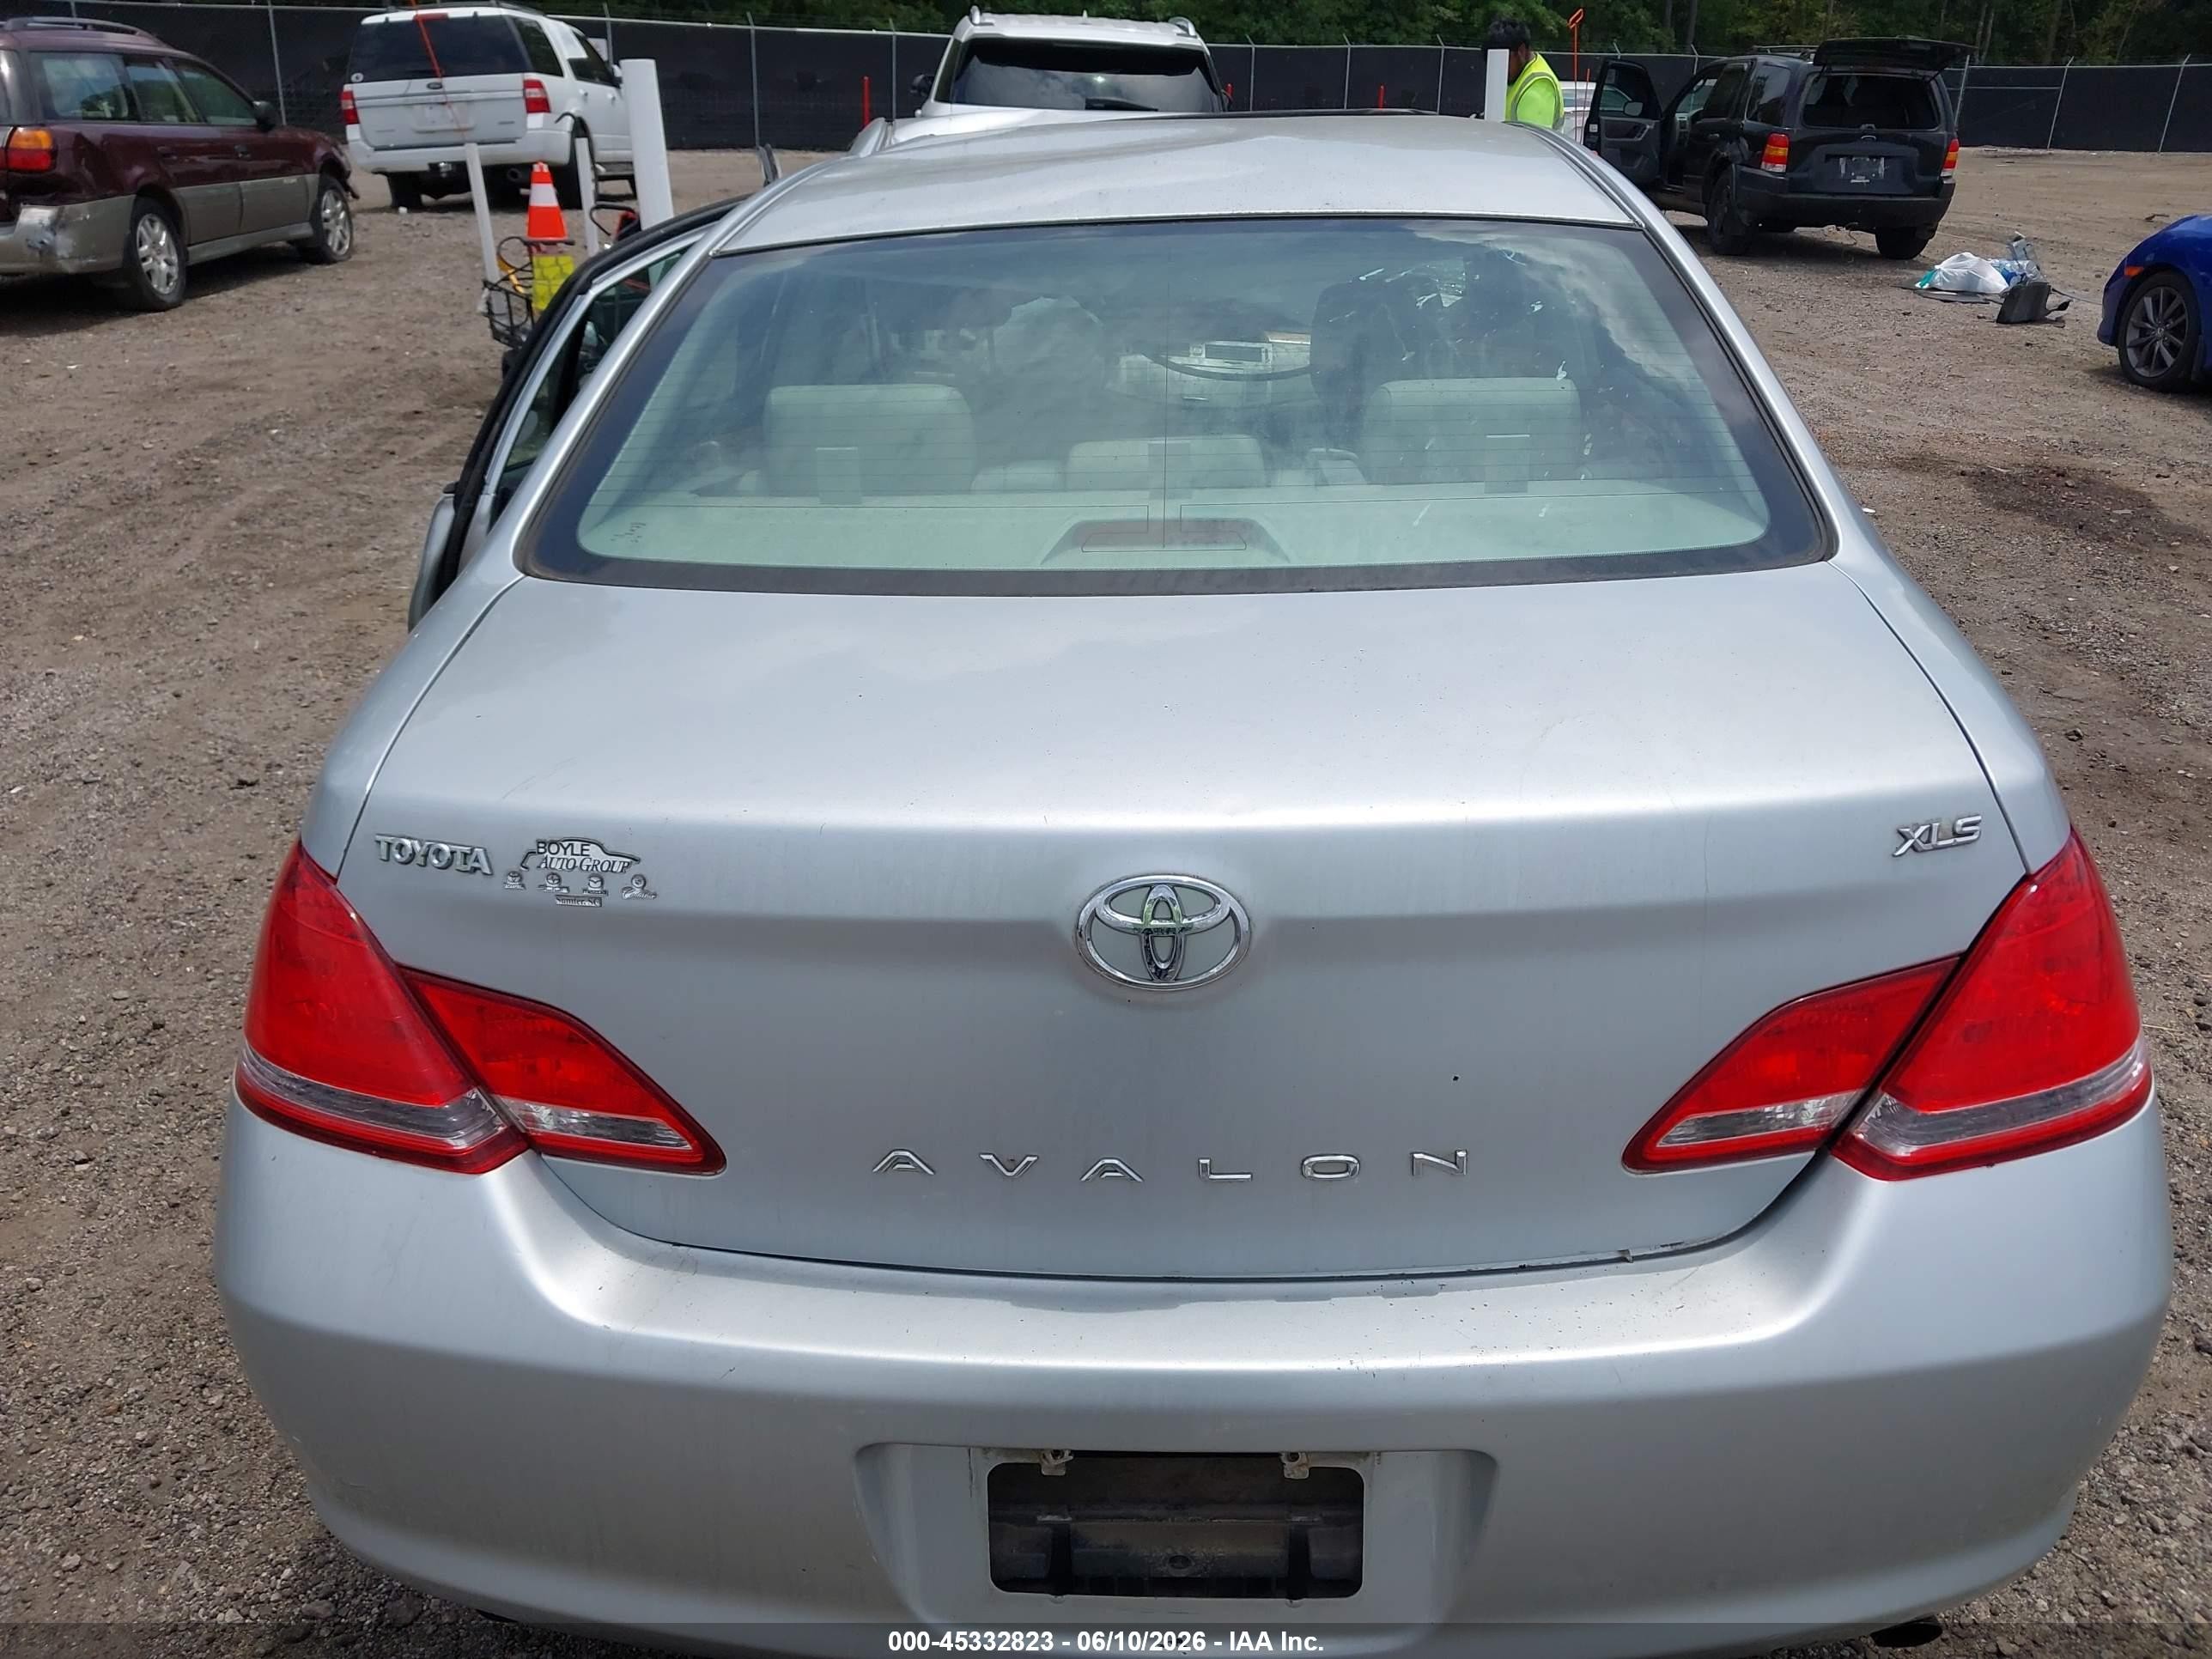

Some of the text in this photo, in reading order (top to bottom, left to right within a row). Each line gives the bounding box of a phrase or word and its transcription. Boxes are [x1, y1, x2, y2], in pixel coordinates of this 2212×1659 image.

[537, 841, 592, 856] BOYLE
[1892, 815, 1982, 857] XLS
[374, 833, 495, 876] TOYOTA
[537, 855, 633, 873] AUTO GROUP
[872, 1148, 1468, 1183] AVALON
